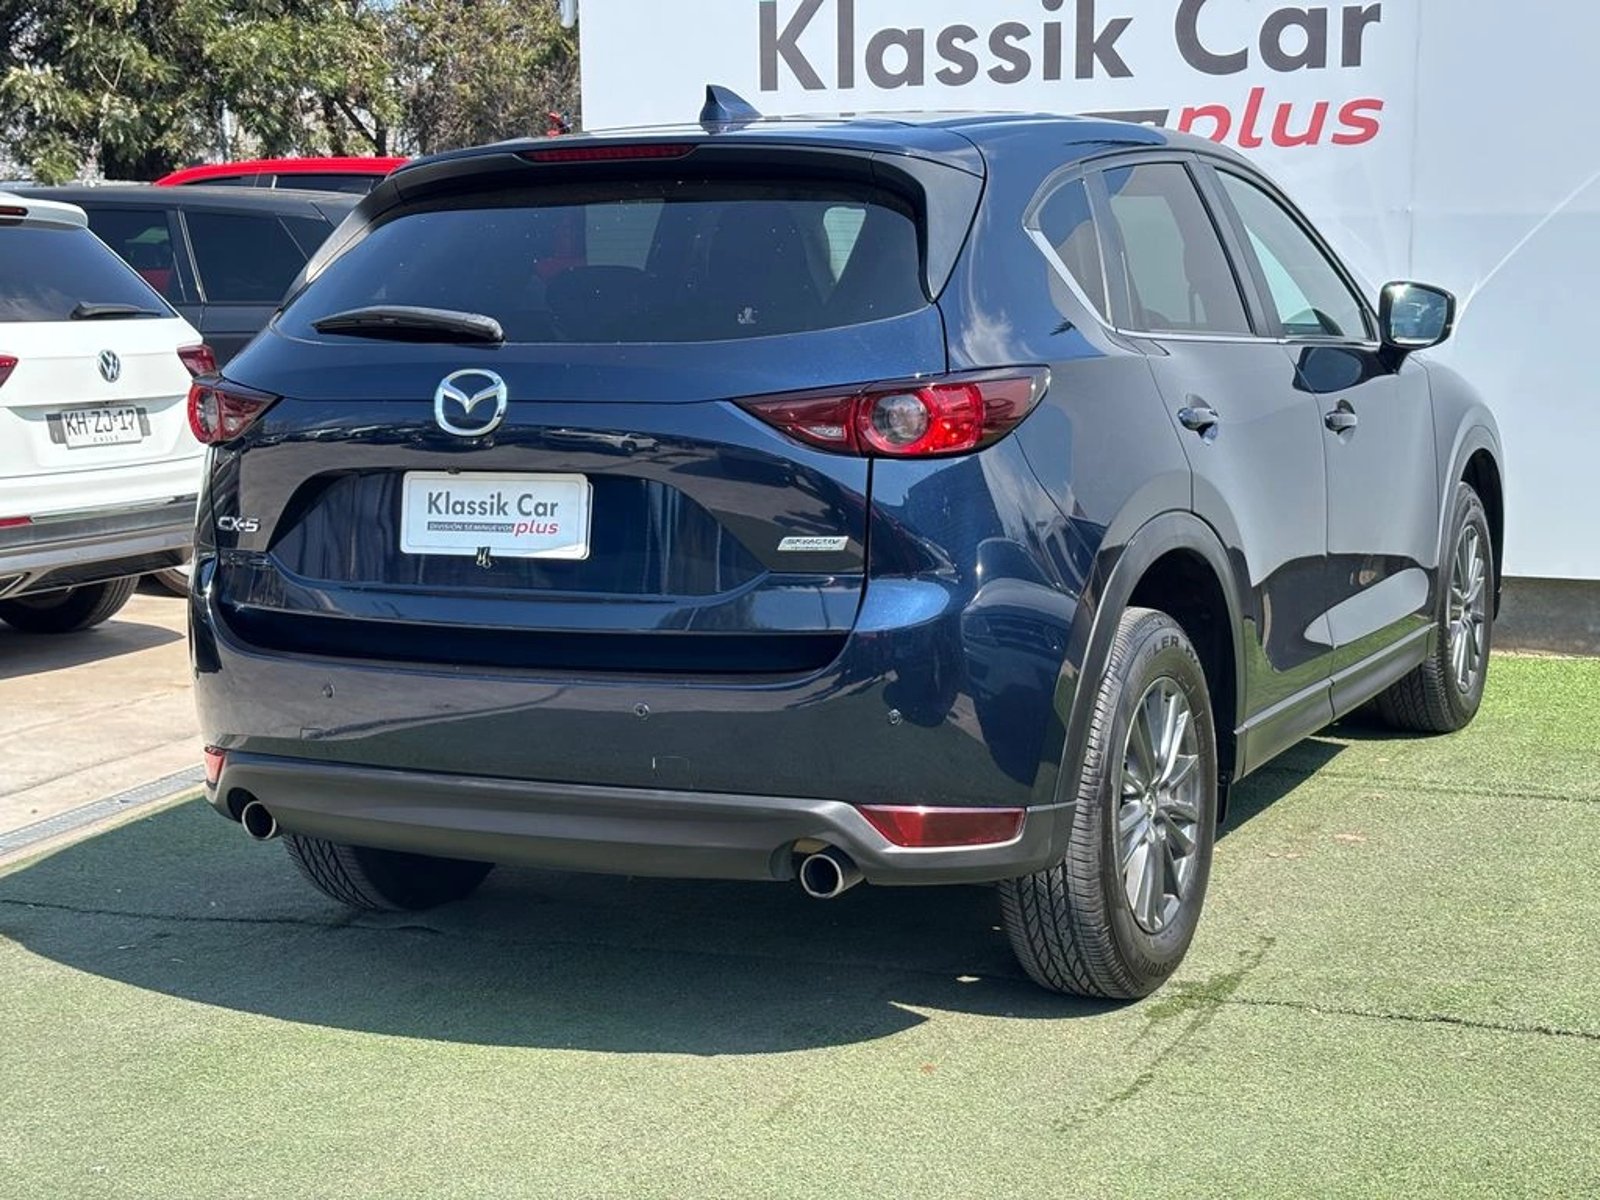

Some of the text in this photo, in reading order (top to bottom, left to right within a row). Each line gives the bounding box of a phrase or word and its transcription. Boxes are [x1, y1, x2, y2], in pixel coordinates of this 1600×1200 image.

[758, 0, 1382, 92] Klassik Car
[1177, 86, 1384, 149] plus
[428, 491, 559, 518] Klassik Car
[218, 517, 259, 532] CX-5
[513, 519, 559, 537] plus
